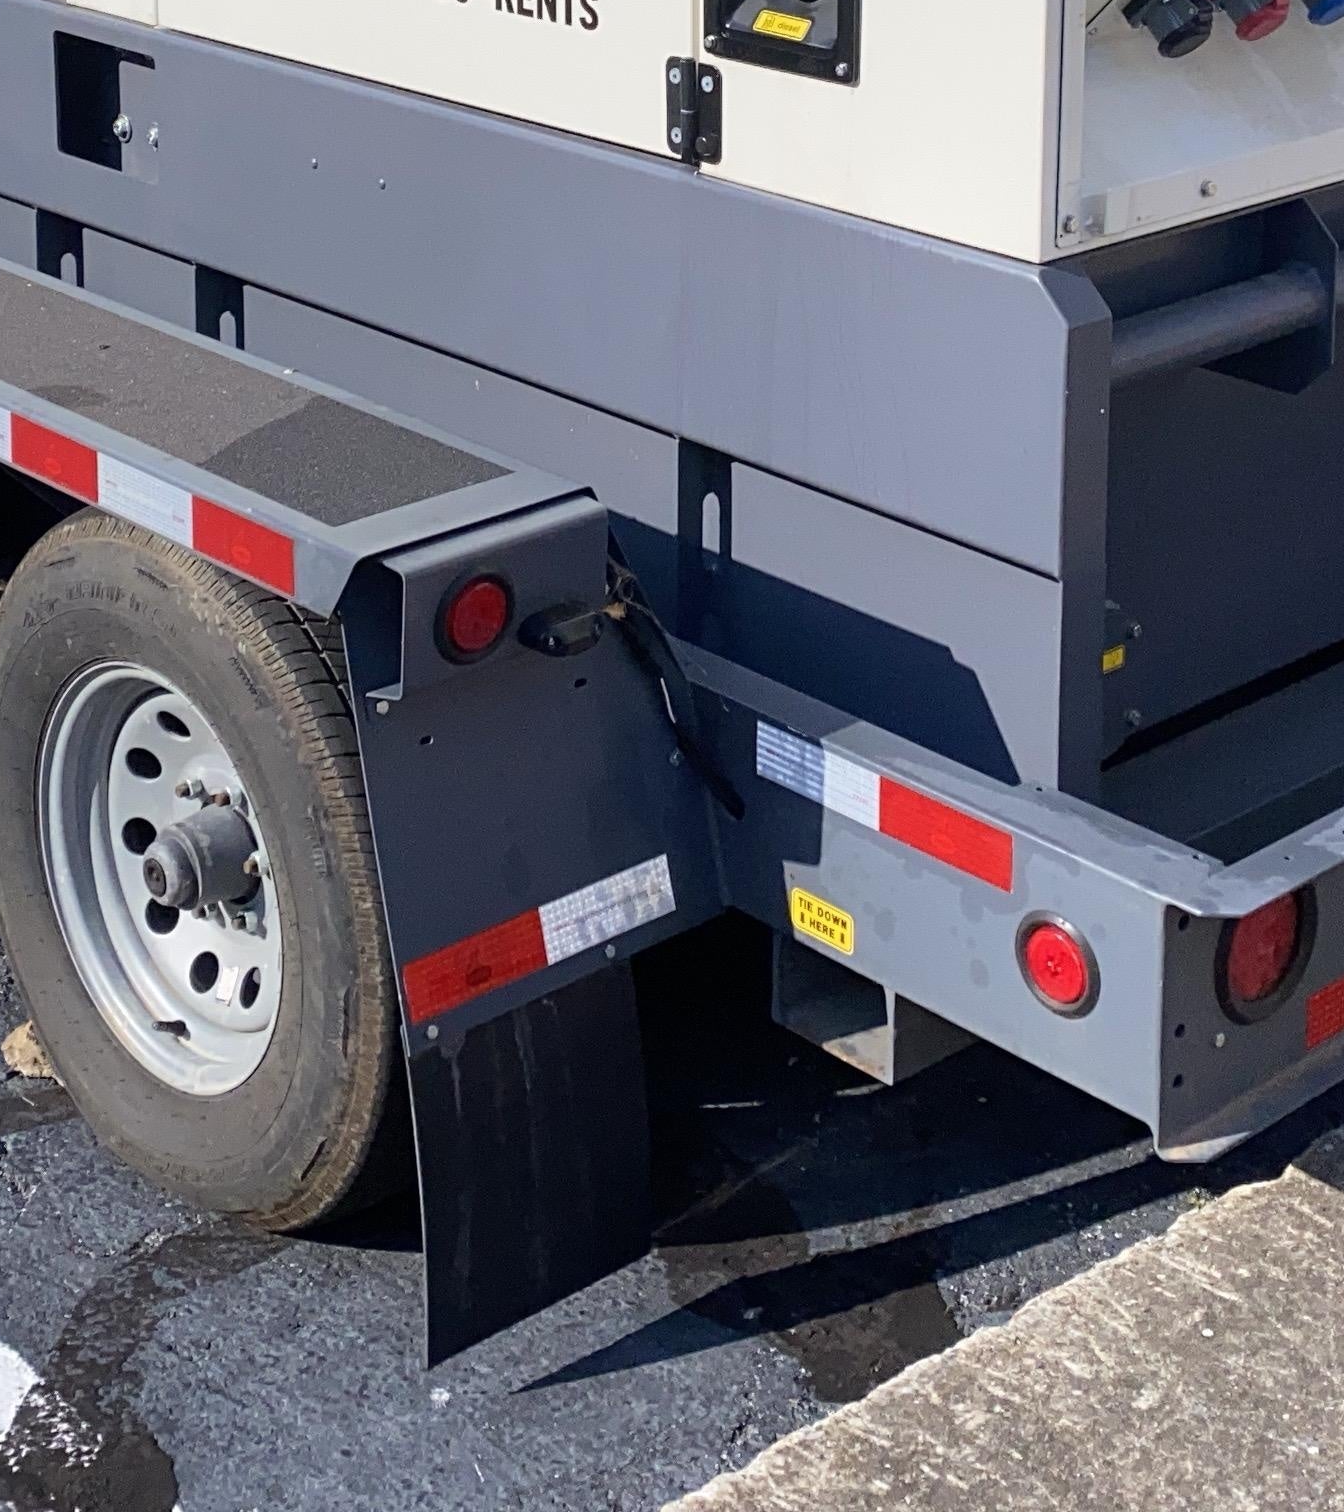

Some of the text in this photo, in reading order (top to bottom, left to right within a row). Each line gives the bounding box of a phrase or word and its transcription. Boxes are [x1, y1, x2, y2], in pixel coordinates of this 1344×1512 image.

[798, 896, 847, 930] TIE DOWN
[809, 917, 835, 939] HERE
